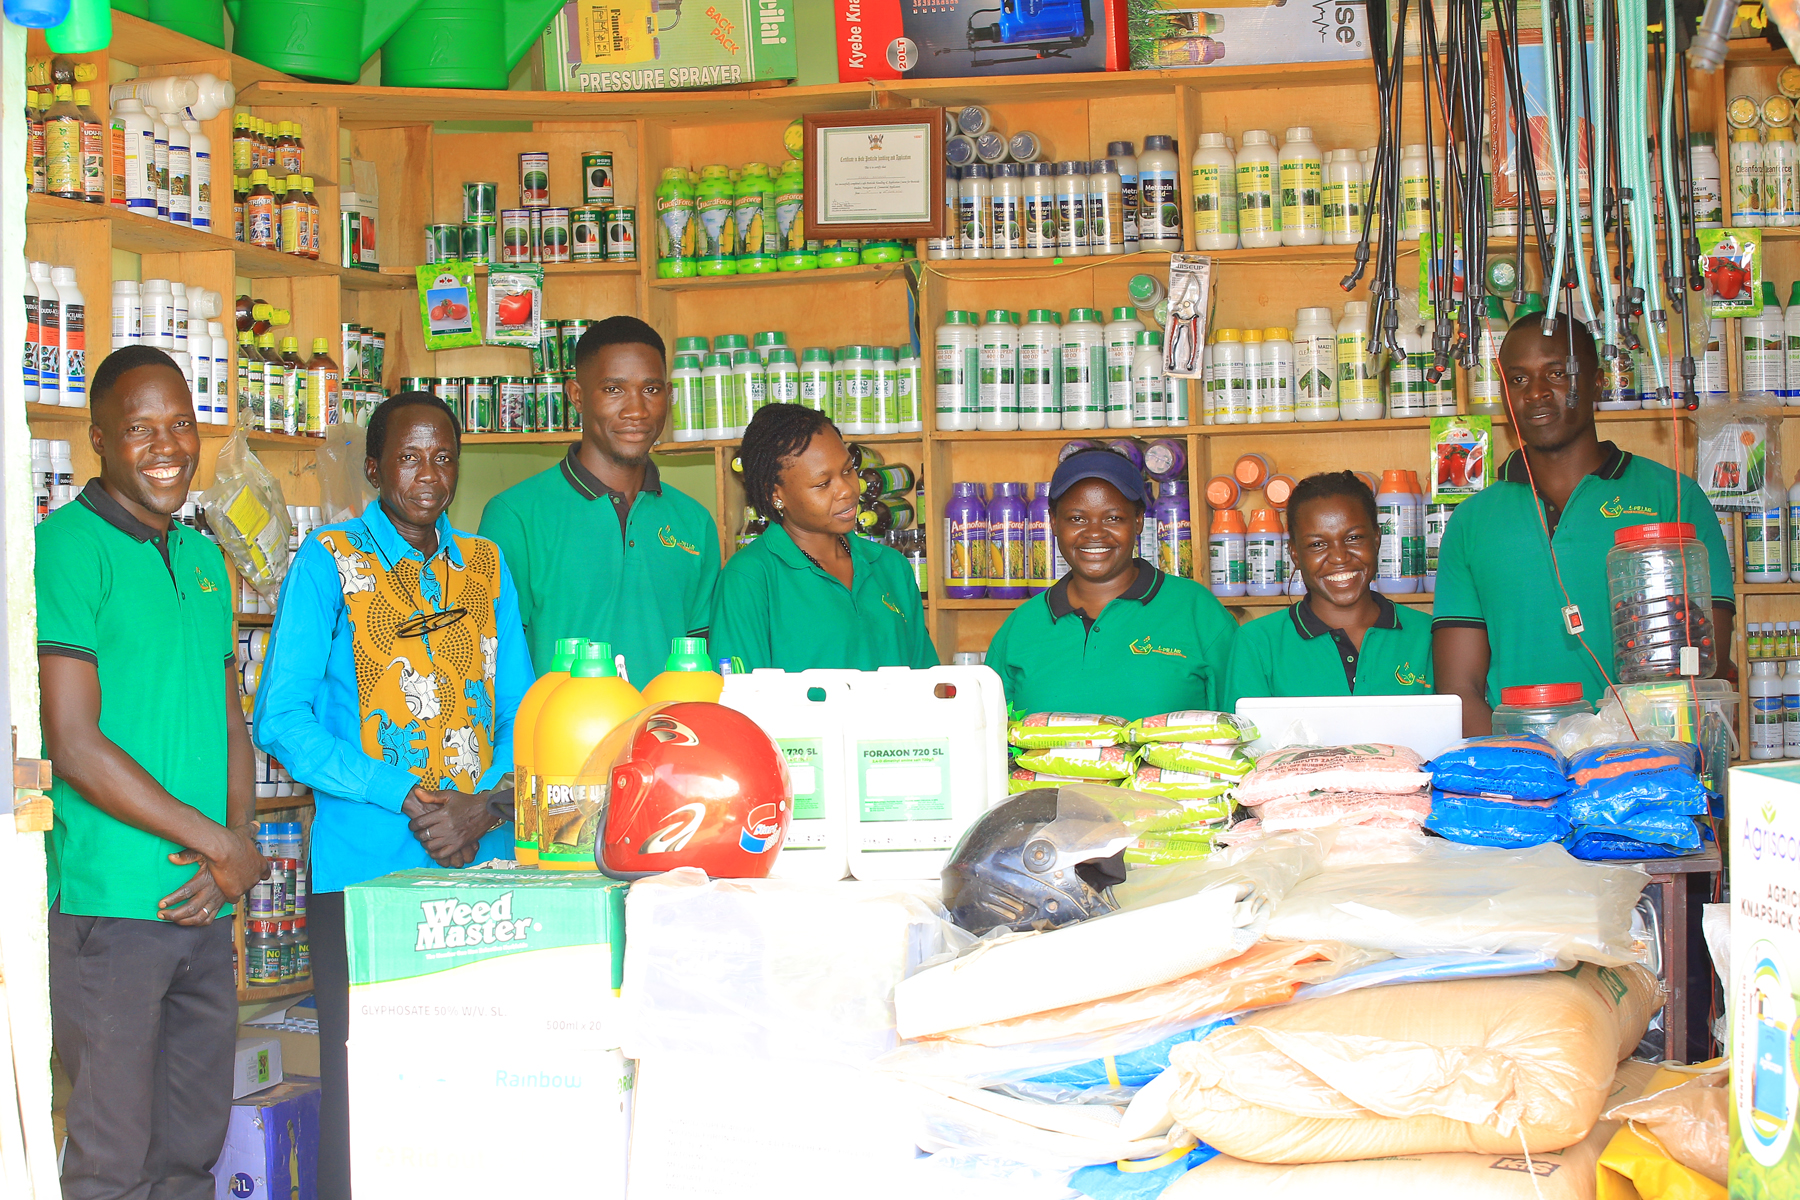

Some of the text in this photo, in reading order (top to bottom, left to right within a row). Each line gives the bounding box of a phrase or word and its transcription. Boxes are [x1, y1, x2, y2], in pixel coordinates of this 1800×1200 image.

[705, 6, 736, 34] BACK
[710, 27, 741, 56] PACK
[848, 26, 867, 68] Kyebe
[898, 39, 908, 70] 20LT
[580, 64, 742, 92] PRESSURE SPRAYER
[1144, 184, 1173, 192] Metrazin
[864, 749, 910, 757] FORAXON
[547, 784, 586, 804] FORCE
[421, 890, 514, 926] Weed
[1741, 898, 1794, 930] KNAPSACK
[415, 917, 533, 951] Master
[362, 1005, 430, 1016] GLYPHOSATE
[434, 1006, 458, 1016] 50%
[546, 1020, 578, 1031] 500ml
[589, 1020, 601, 1031] 20
[496, 1070, 582, 1088] Rainbow
